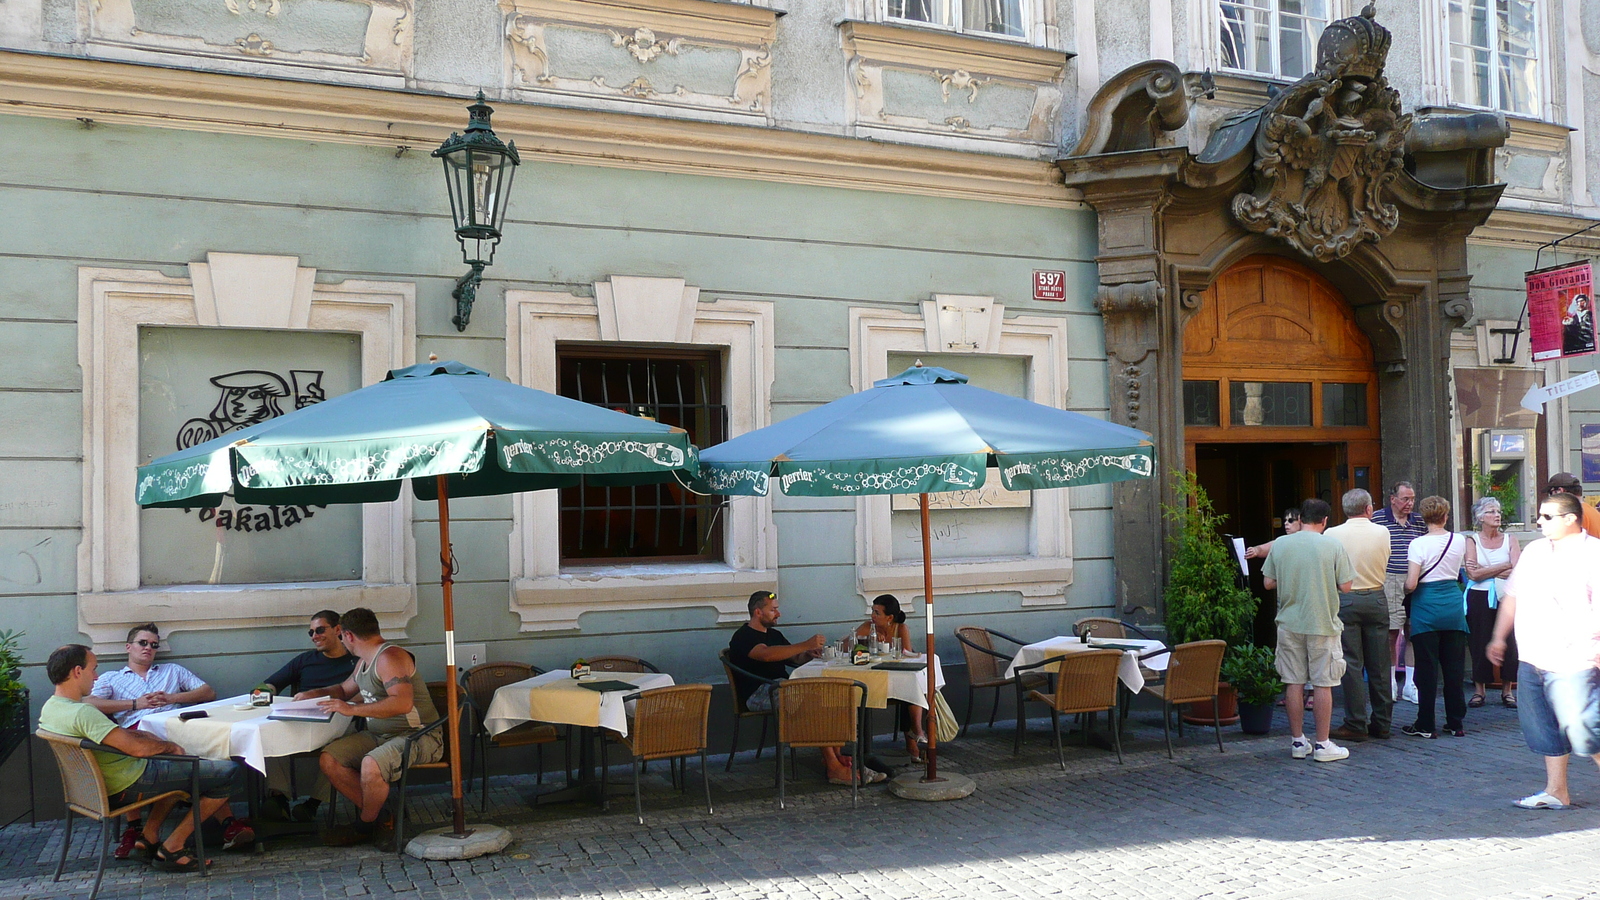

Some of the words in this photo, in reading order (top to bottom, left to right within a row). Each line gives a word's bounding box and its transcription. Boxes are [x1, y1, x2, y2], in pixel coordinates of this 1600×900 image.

[1039, 272, 1060, 285] 597
[1529, 280, 1546, 291] Don
[1549, 273, 1590, 287] Giovanni
[1546, 373, 1598, 397] TICKETS
